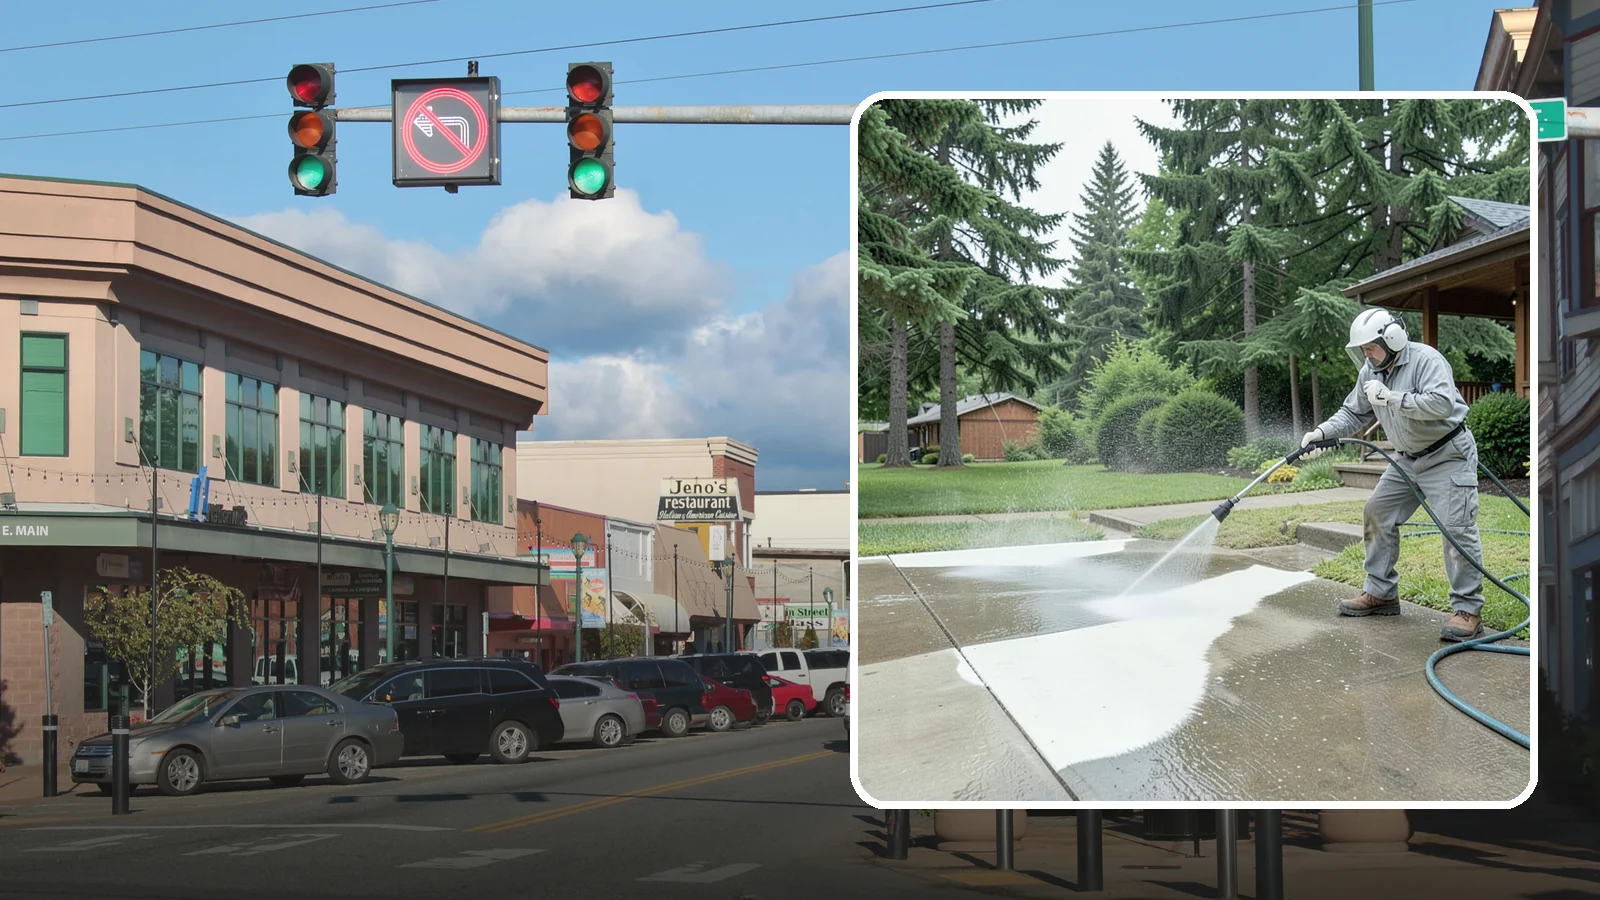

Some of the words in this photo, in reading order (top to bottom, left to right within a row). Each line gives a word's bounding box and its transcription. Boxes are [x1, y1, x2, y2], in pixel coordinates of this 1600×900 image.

[669, 479, 728, 495] Jeno's
[665, 496, 731, 509] restaurant
[658, 509, 682, 520] Italian
[686, 509, 715, 520] American
[715, 509, 738, 519] Cuisine
[2, 525, 13, 536] E.
[15, 525, 49, 536] MAIN
[797, 607, 829, 617] Street
[789, 619, 824, 627] lass
